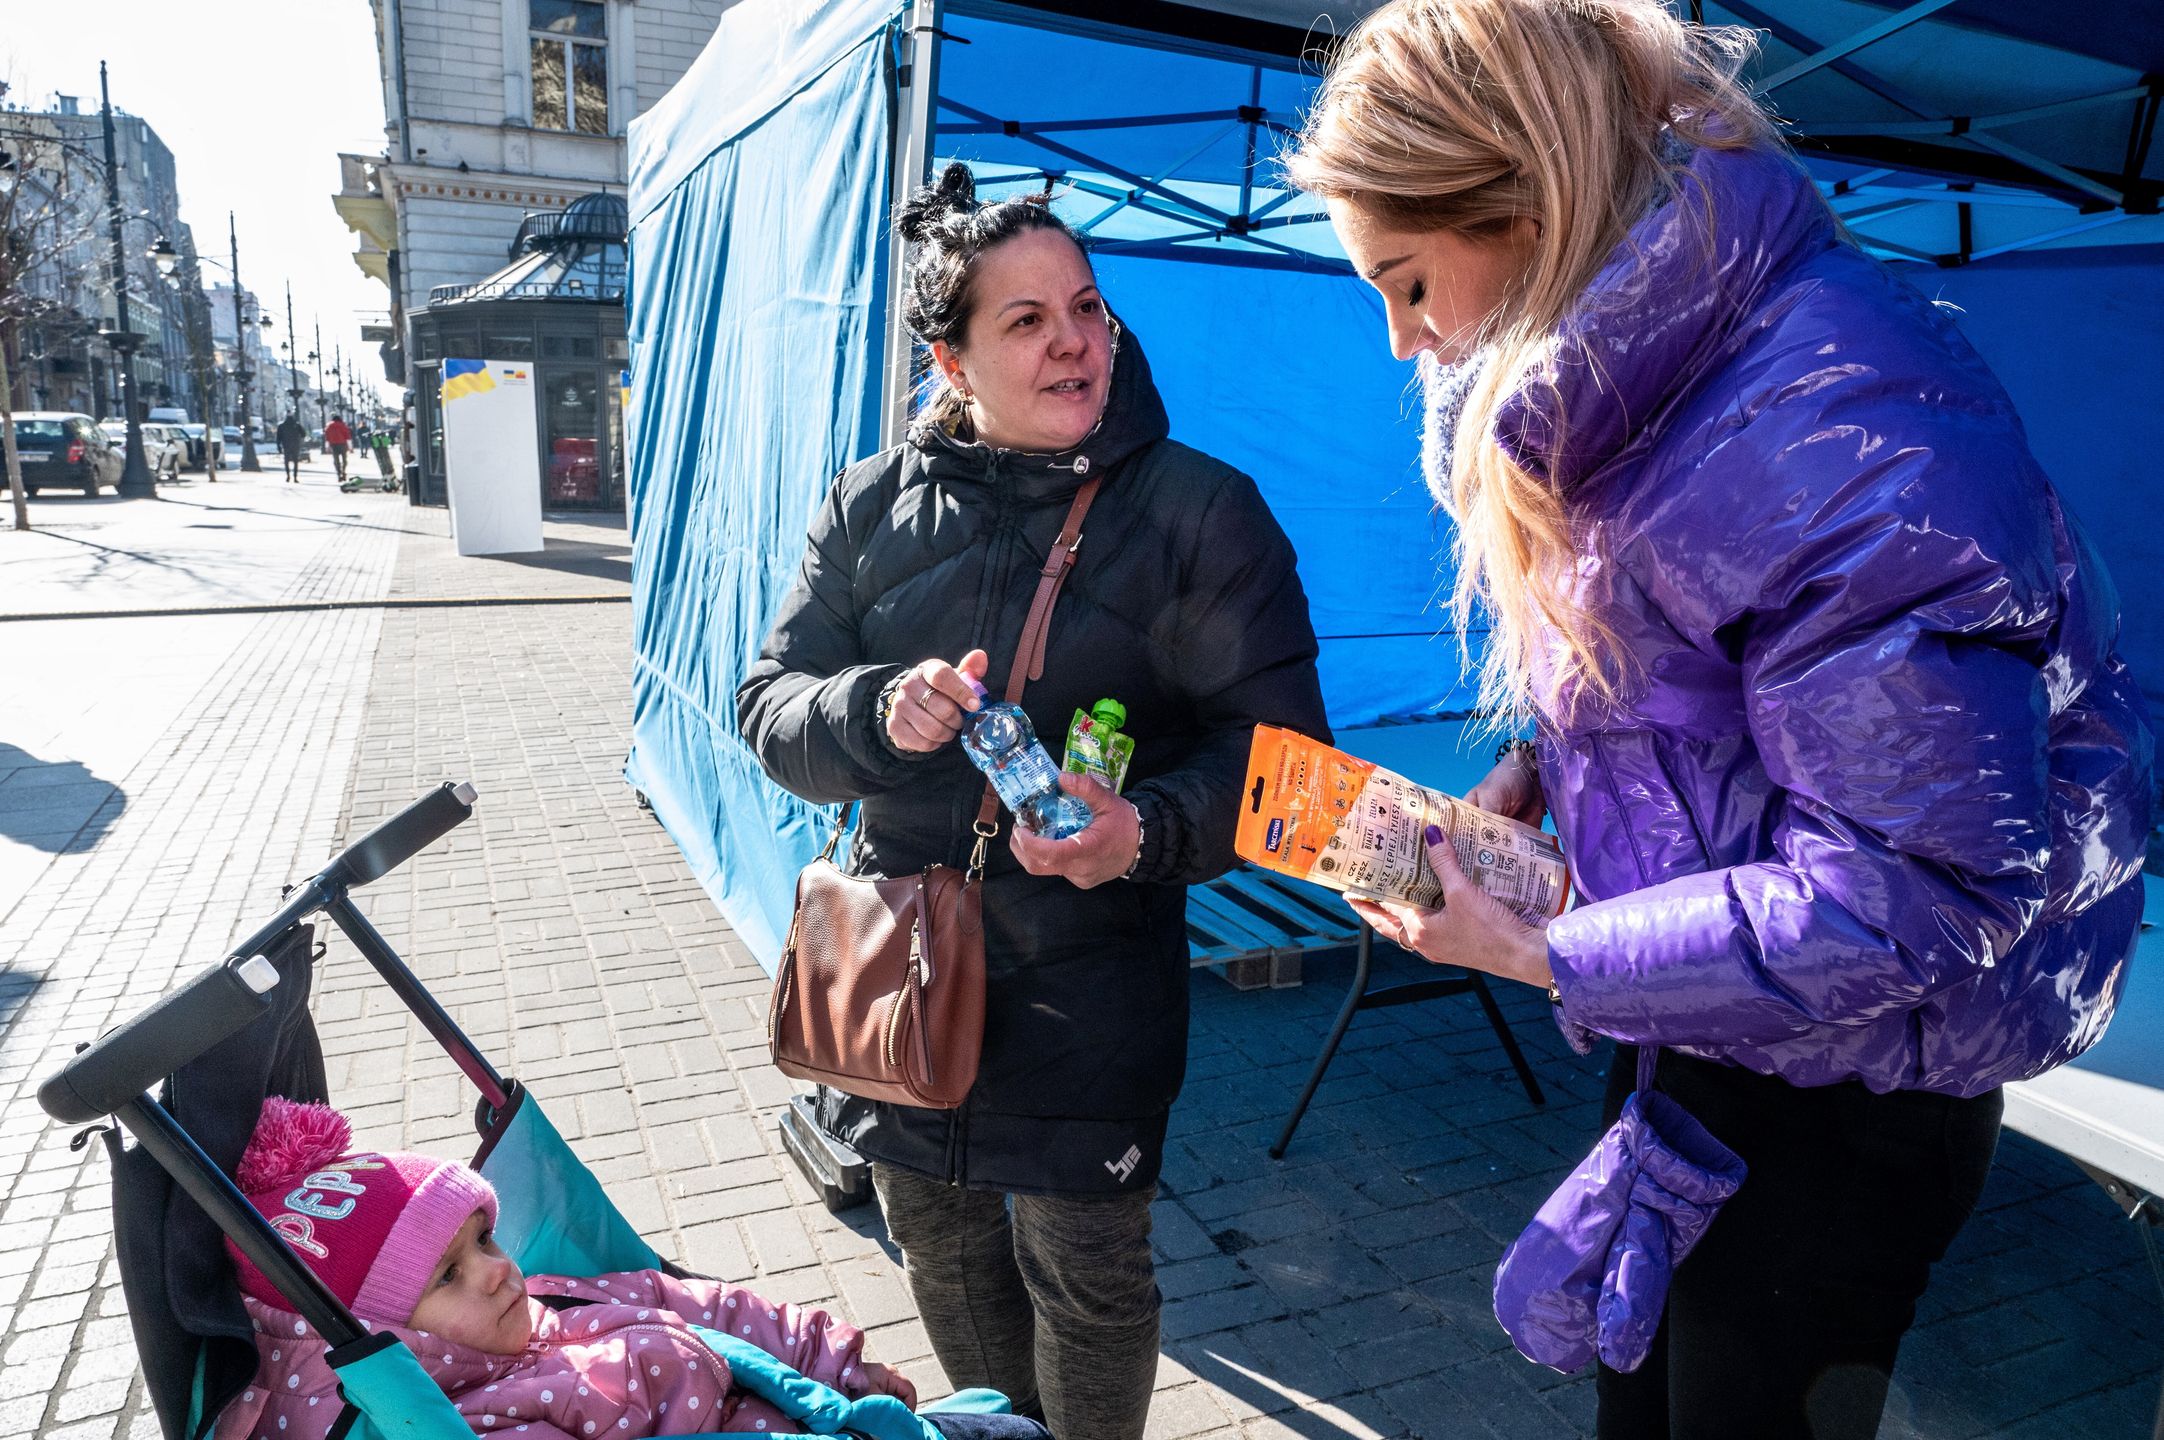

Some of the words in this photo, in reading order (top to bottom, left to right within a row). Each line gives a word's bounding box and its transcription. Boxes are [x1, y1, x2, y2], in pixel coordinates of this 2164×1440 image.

[1347, 861, 1358, 877] CZY
[1375, 871, 1391, 892] JESZ
[1386, 835, 1398, 869] LEPIEJ,
[1504, 857, 1517, 871] 95g
